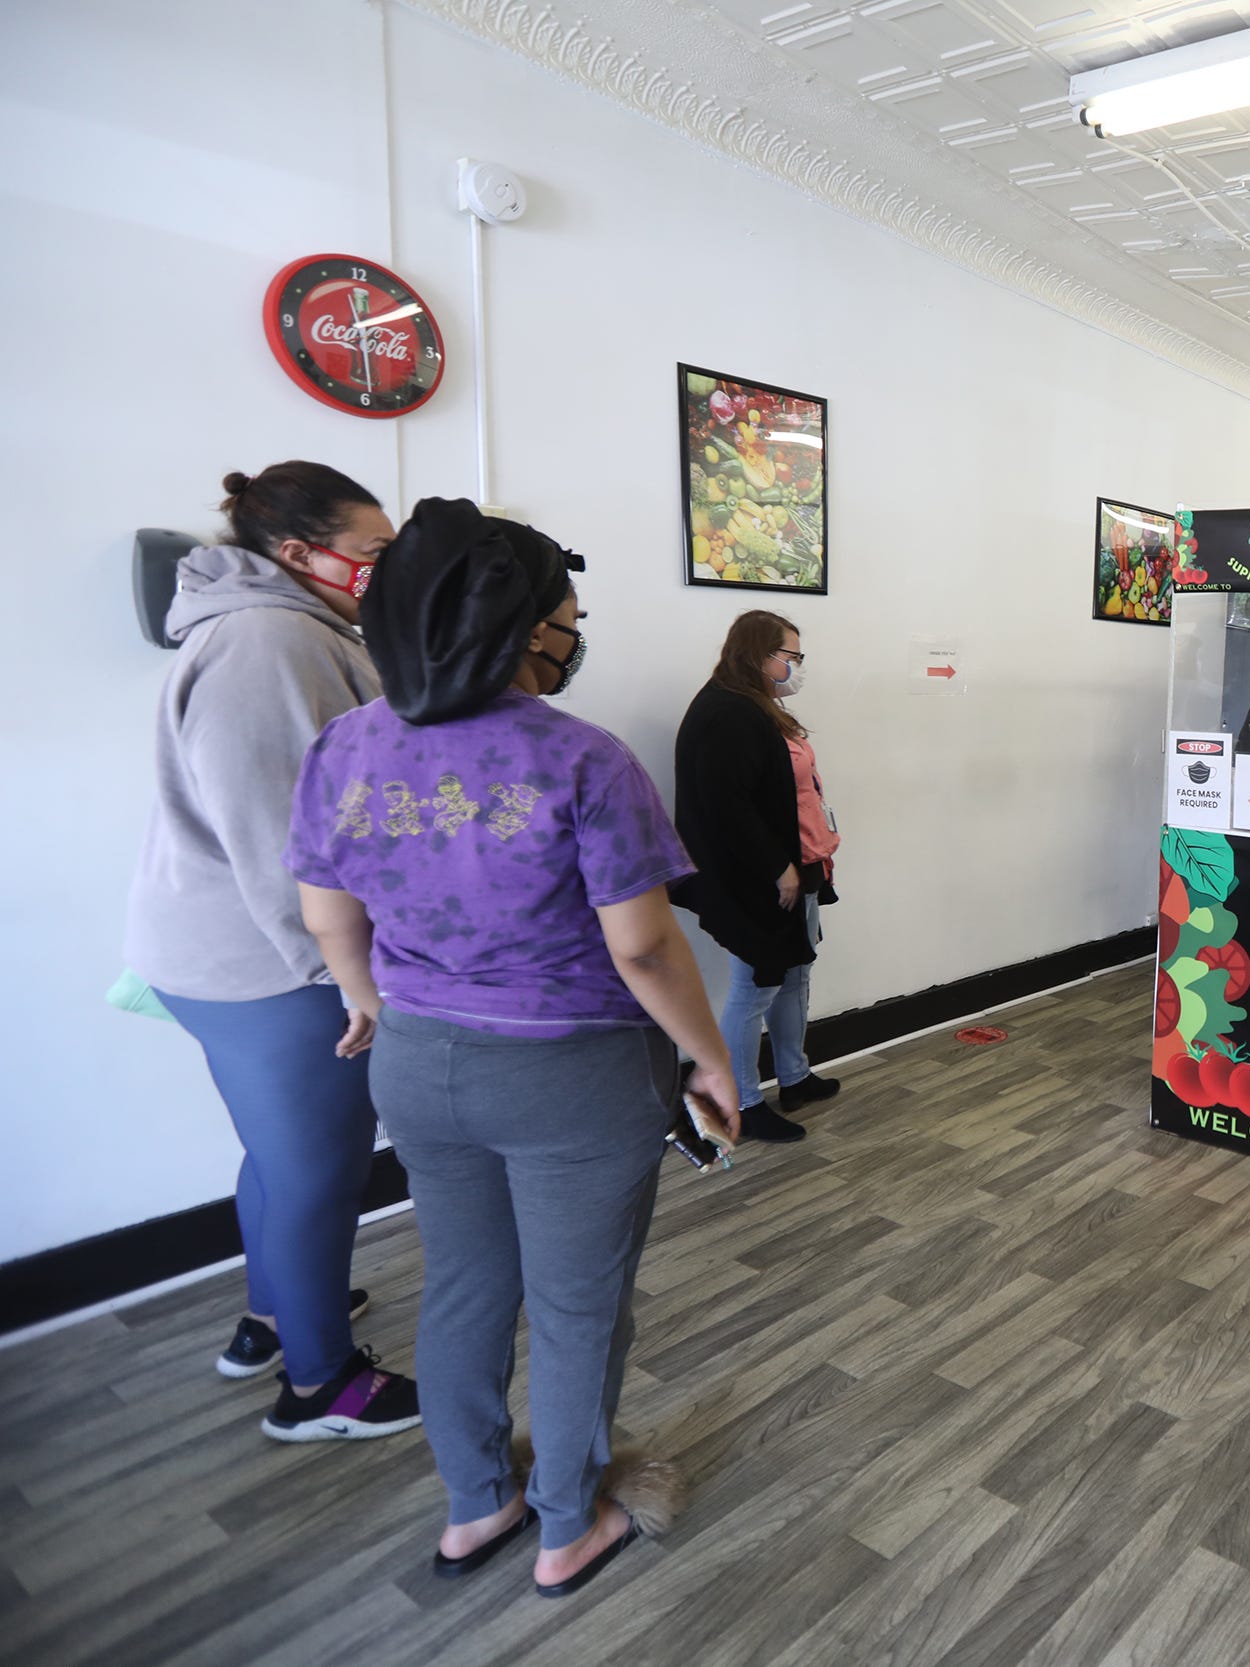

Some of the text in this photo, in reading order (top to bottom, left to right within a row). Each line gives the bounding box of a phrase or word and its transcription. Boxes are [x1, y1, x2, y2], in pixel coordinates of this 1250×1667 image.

[351, 268, 367, 282] 12
[283, 314, 294, 327] 9
[425, 347, 434, 358] 3
[360, 394, 370, 405] 6
[1189, 743, 1211, 752] STOP
[1177, 789, 1221, 798] FACE MASK
[1180, 799, 1218, 808] REQUIRED
